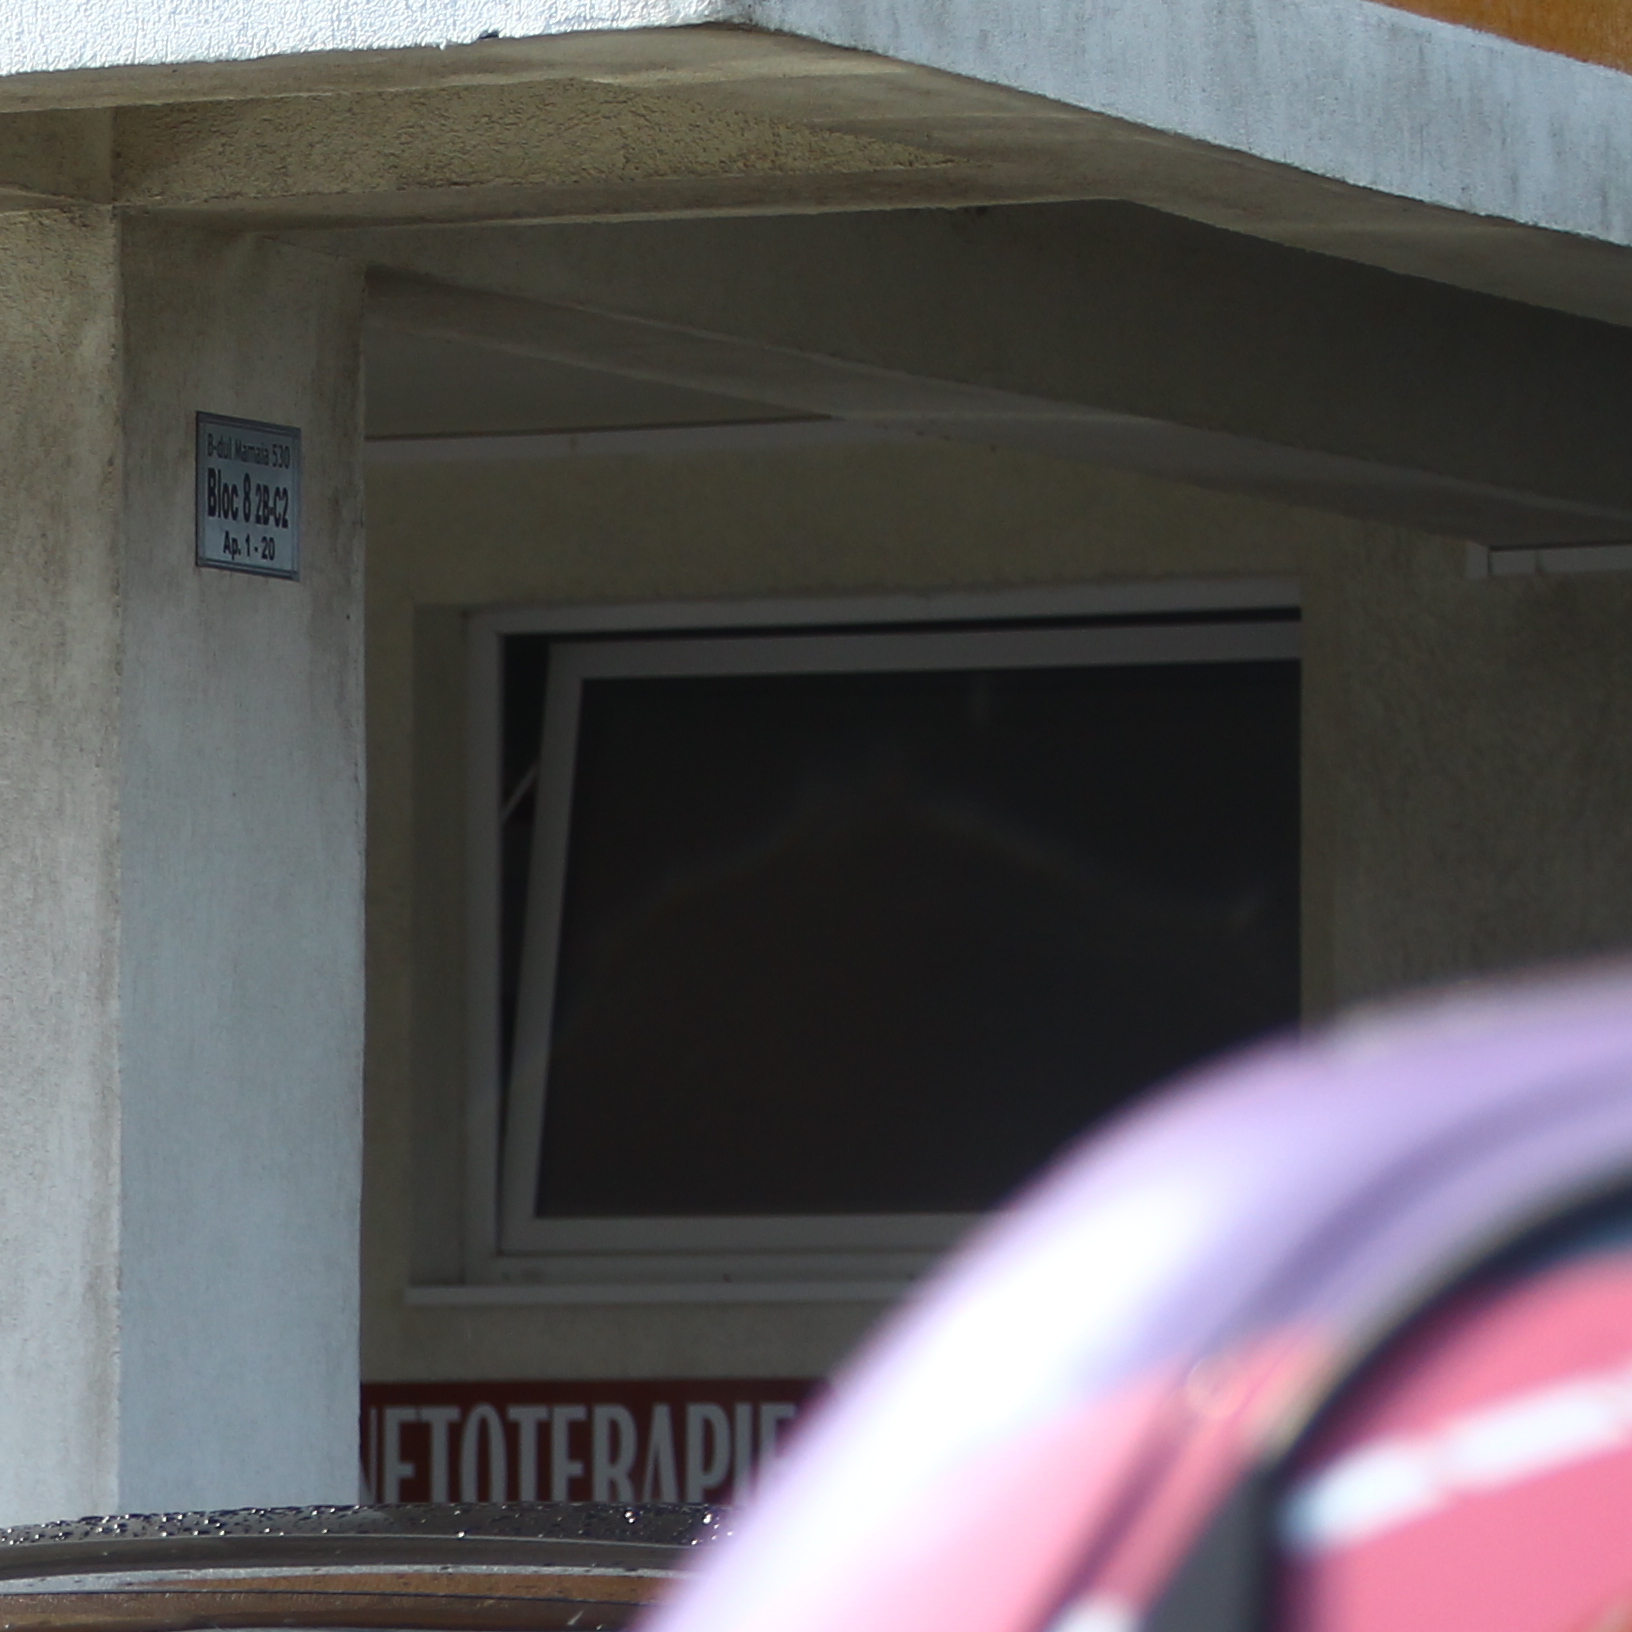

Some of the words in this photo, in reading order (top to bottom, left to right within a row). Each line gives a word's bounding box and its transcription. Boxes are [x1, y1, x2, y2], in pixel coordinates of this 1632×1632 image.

[207, 467, 239, 521] Bloc
[243, 472, 252, 523] 8
[255, 482, 289, 529] 2B-C2
[223, 530, 241, 560] Ap.
[245, 533, 251, 557] 1
[261, 536, 276, 561] 20
